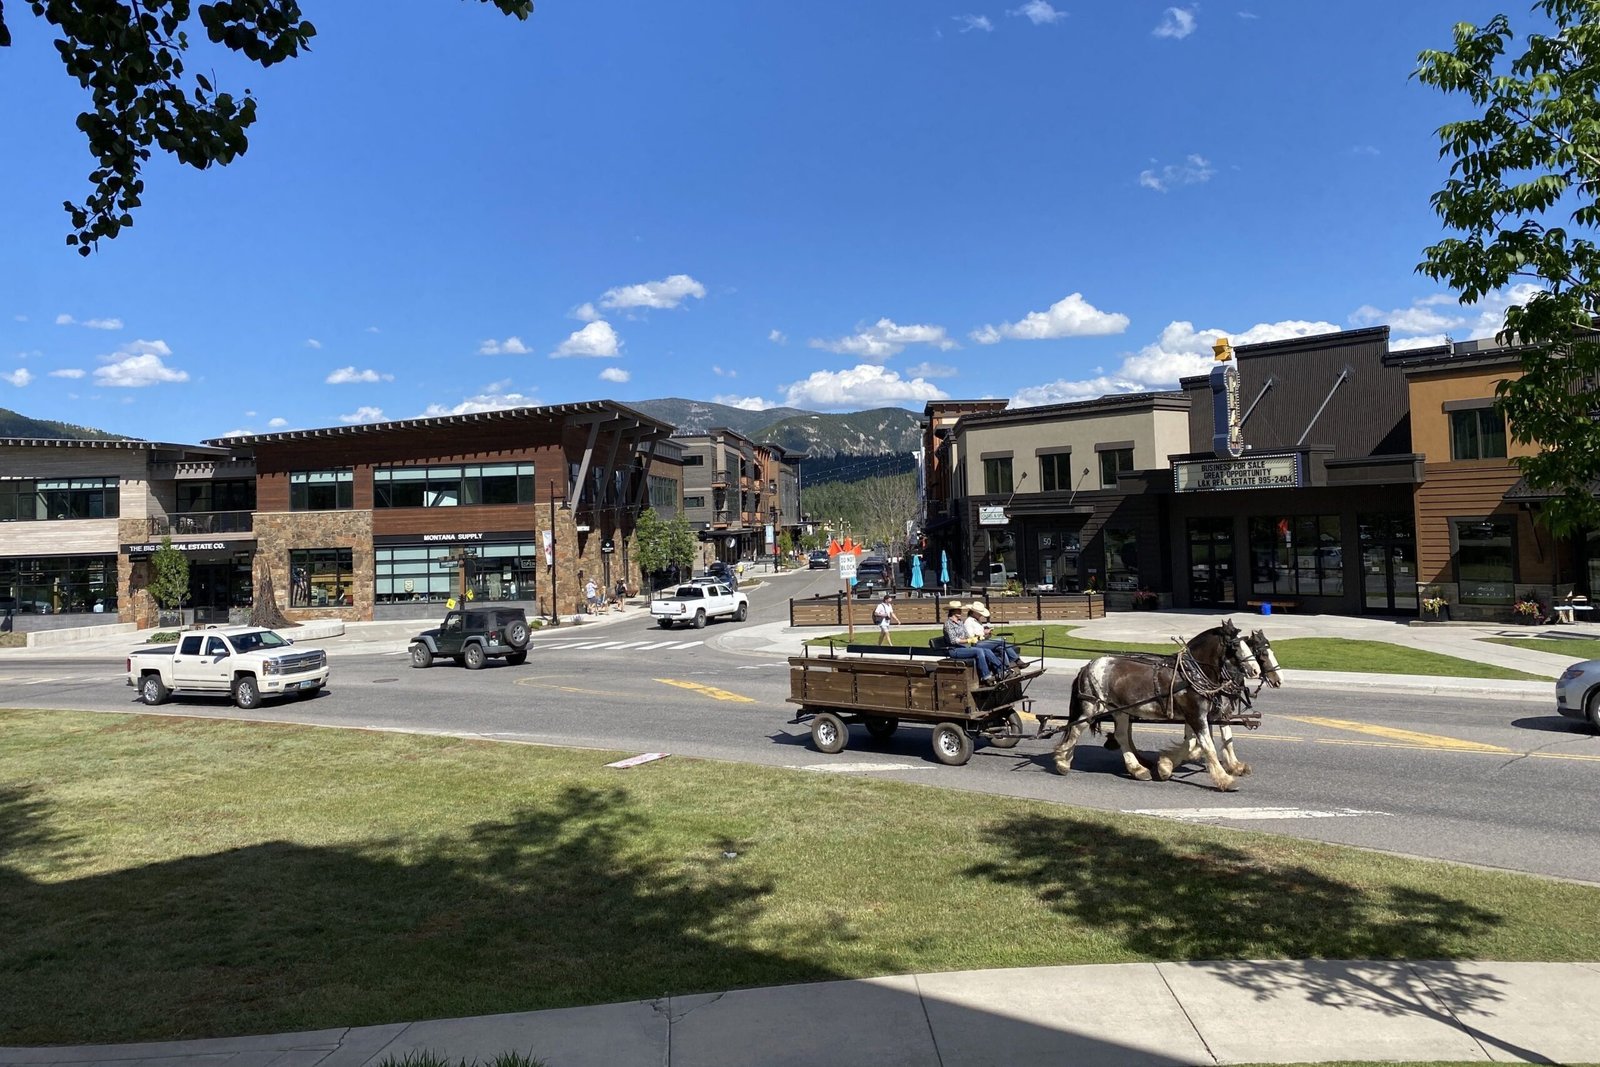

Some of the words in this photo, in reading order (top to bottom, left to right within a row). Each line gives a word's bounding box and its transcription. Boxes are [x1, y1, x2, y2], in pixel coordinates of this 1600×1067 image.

[1201, 463, 1232, 472] BUSINESS
[1234, 462, 1246, 470] FOR
[1248, 461, 1265, 469] SALE
[1203, 471, 1224, 479] GREAT
[1226, 468, 1272, 478] OPPORTUNITY
[1197, 479, 1211, 487] L&K
[1212, 478, 1228, 486] REAL
[1231, 477, 1256, 485] ESTATE
[1258, 475, 1293, 484] 995-2404
